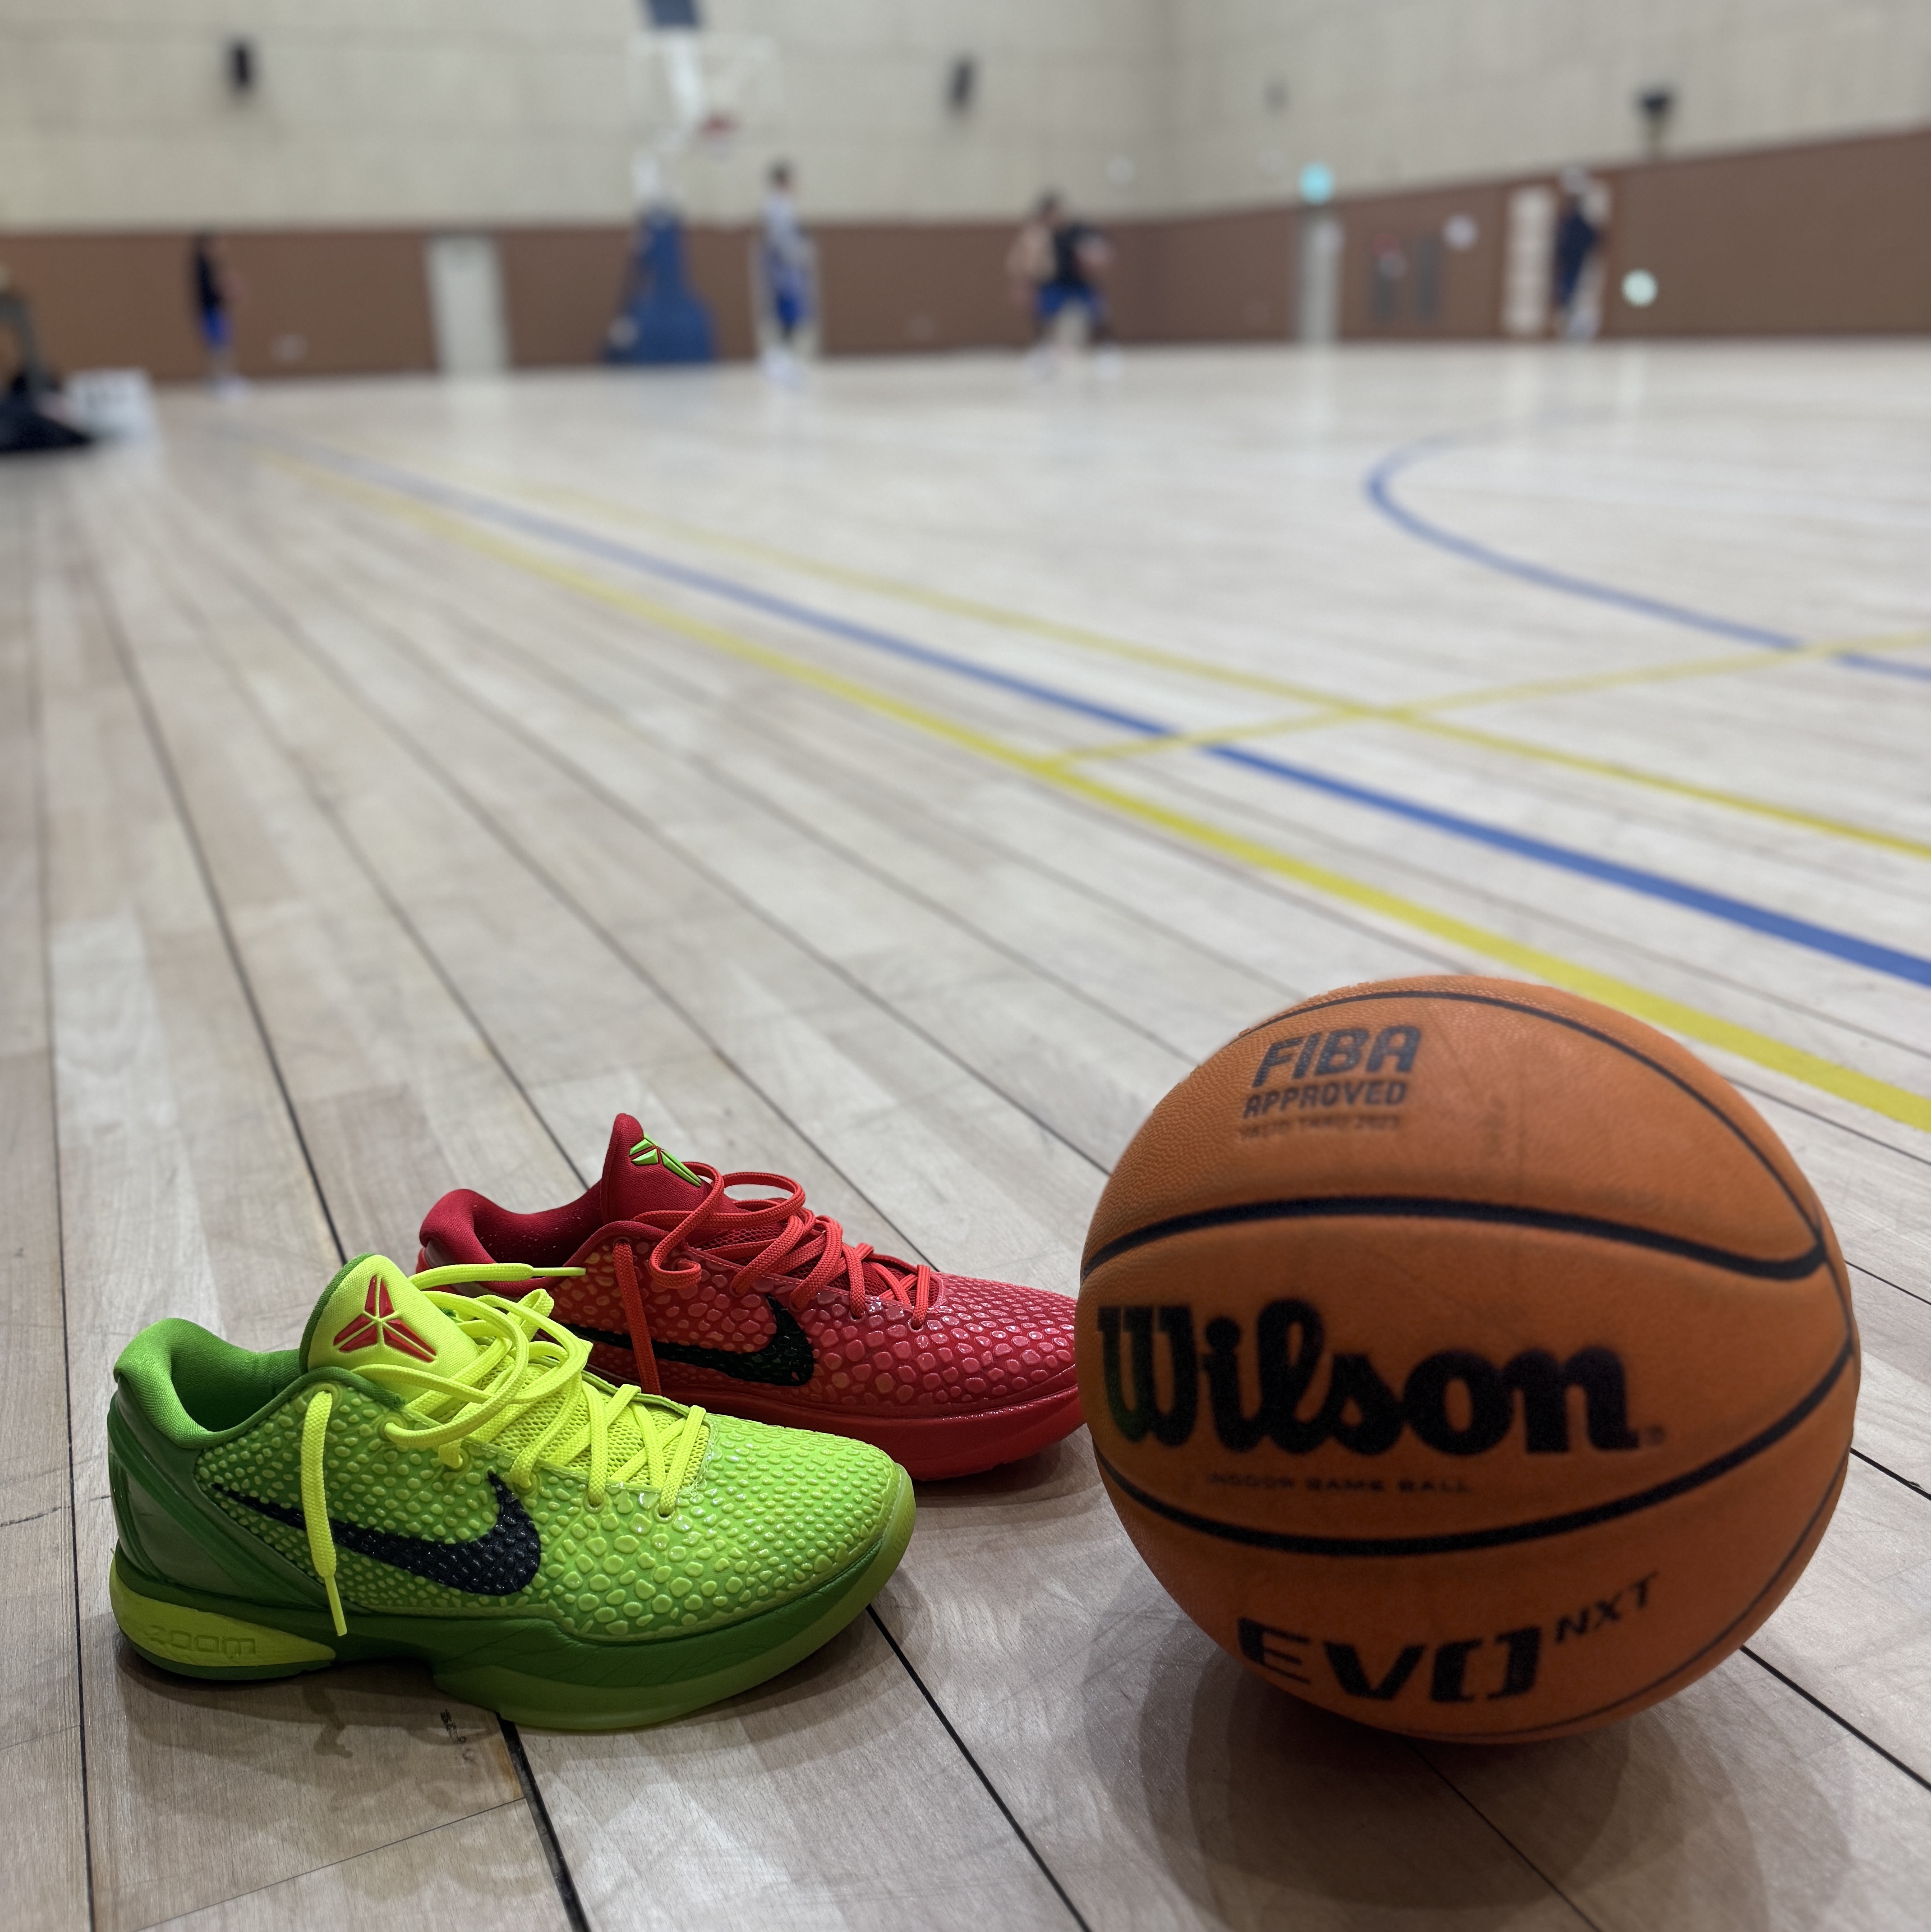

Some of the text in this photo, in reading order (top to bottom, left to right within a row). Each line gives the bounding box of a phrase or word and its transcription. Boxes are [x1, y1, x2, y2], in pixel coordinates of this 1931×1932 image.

[1243, 1081, 1407, 1119] APPROVED
[1252, 1024, 1422, 1088] FIBA
[1097, 1299, 1639, 1456] Wilson
[1237, 1571, 1659, 1703] EVO NXT
